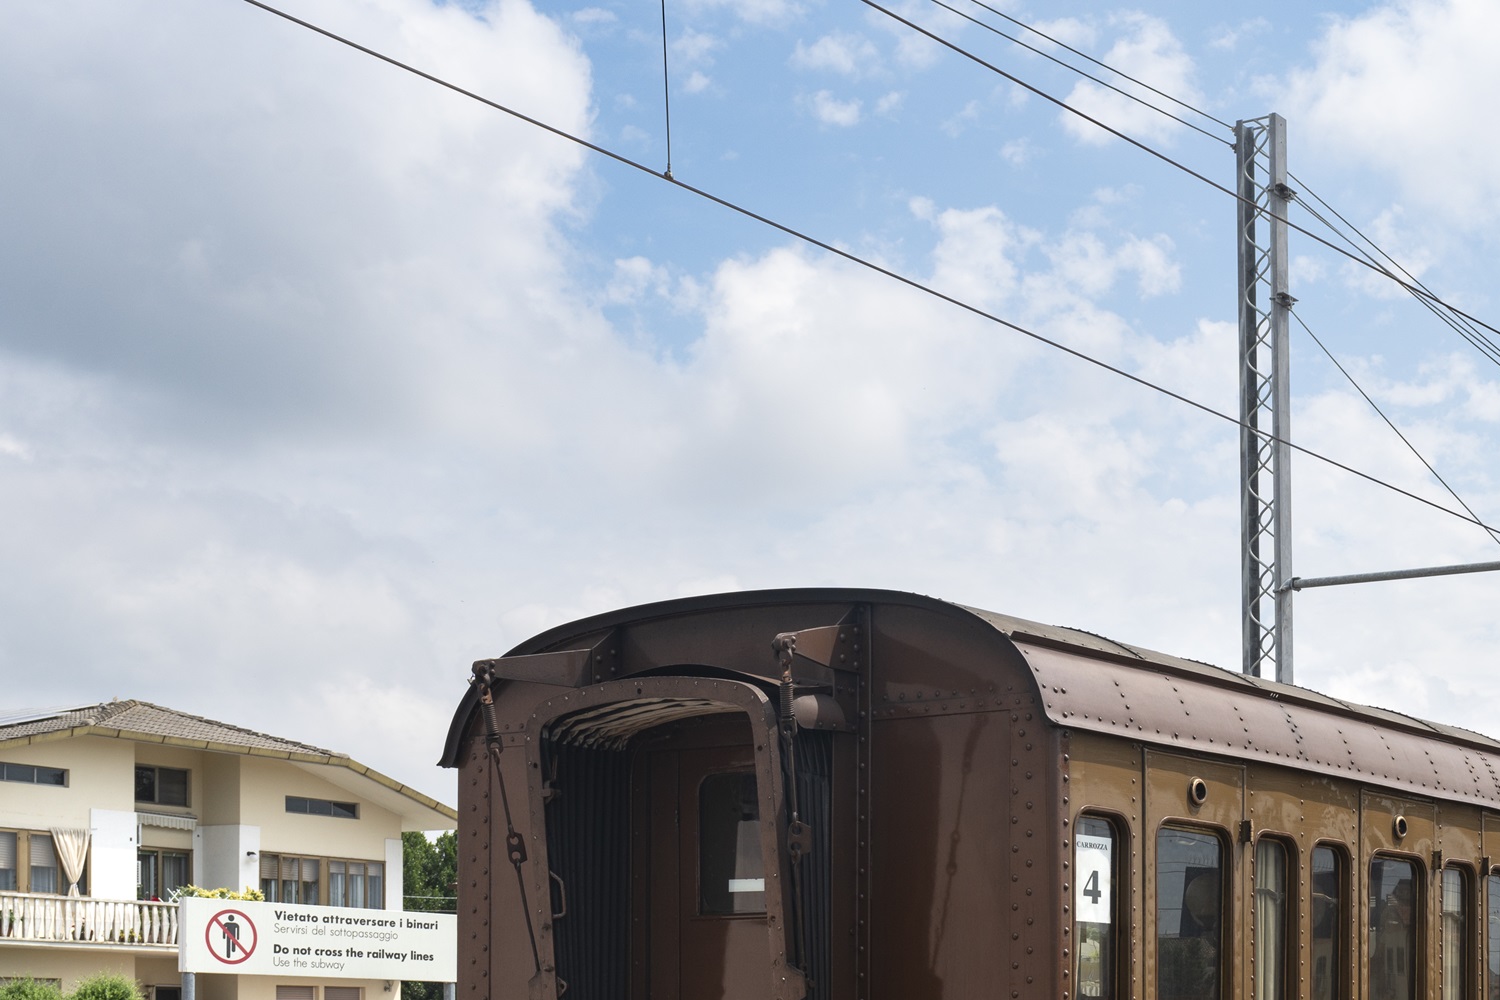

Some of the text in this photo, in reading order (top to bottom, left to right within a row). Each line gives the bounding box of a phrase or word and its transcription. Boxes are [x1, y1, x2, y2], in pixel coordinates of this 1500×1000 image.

[1076, 841, 1108, 851] CARROZZA
[1083, 870, 1102, 905] 4
[274, 910, 319, 923] Vietato
[322, 914, 396, 928] attraversare
[406, 918, 439, 930] binari
[273, 922, 399, 942] Servirsi del sottopassaggio
[273, 944, 434, 962] Do not cross the railway lines
[272, 956, 345, 971] Use the subway
